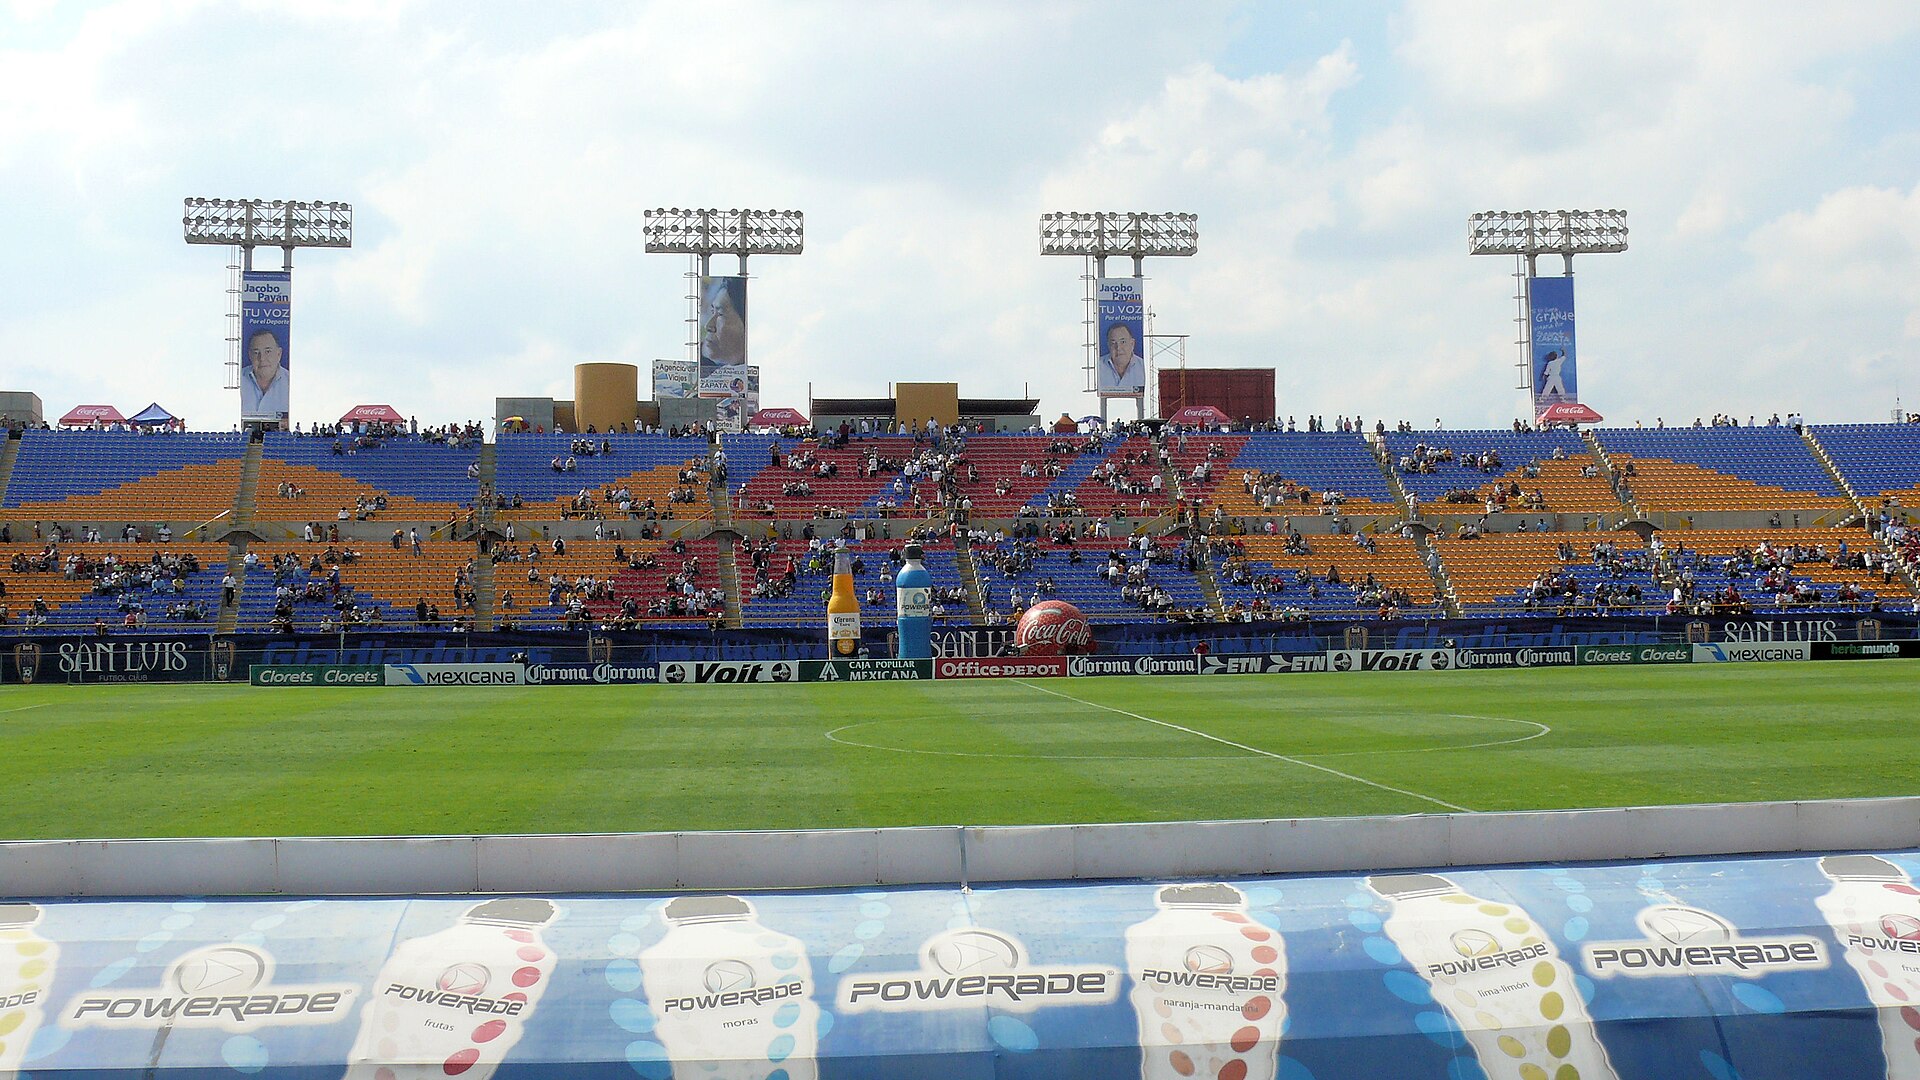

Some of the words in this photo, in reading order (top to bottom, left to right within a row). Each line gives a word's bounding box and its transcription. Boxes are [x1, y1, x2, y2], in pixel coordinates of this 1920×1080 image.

[244, 283, 280, 292] Jacobo
[1099, 283, 1133, 292] Jacobo
[258, 291, 289, 302] Payán
[1112, 291, 1141, 301] Payán
[243, 308, 260, 318] TU
[263, 308, 290, 318] VOZ
[1100, 305, 1115, 314] TU
[1117, 305, 1143, 314] VOZ
[668, 373, 687, 382] Viajes
[1724, 622, 1773, 643] SAN
[1782, 620, 1837, 642] LUIS
[929, 631, 981, 659] SAN
[59, 642, 116, 673] SAN
[125, 641, 188, 673] LUIS
[1361, 652, 1424, 671] Voit
[1455, 650, 1513, 668] Corona
[1516, 648, 1572, 666] Corona
[1584, 650, 1631, 663] Clorets
[1640, 648, 1687, 662] Clorets
[849, 661, 872, 670] CAJA
[876, 660, 915, 668] POPULAR
[941, 662, 1000, 677] Office
[1002, 664, 1059, 676] DEPOT
[1070, 656, 1132, 676] Corona
[1134, 656, 1194, 675] Corona
[1226, 658, 1262, 673] ETN
[1291, 656, 1326, 671] ETN
[98, 674, 128, 682] FUTBOL
[128, 673, 148, 681] CLUB
[260, 669, 314, 683] Clorets
[323, 669, 378, 683] Clorets
[525, 664, 590, 684] Corona
[593, 663, 656, 684] Corona
[695, 663, 764, 683] Voit
[1848, 934, 1920, 953] POWE
[1478, 981, 1530, 998] lima-limón
[1163, 999, 1259, 1013] naranja-mandarina
[424, 1018, 455, 1032] frutas
[722, 1016, 759, 1029] moras
